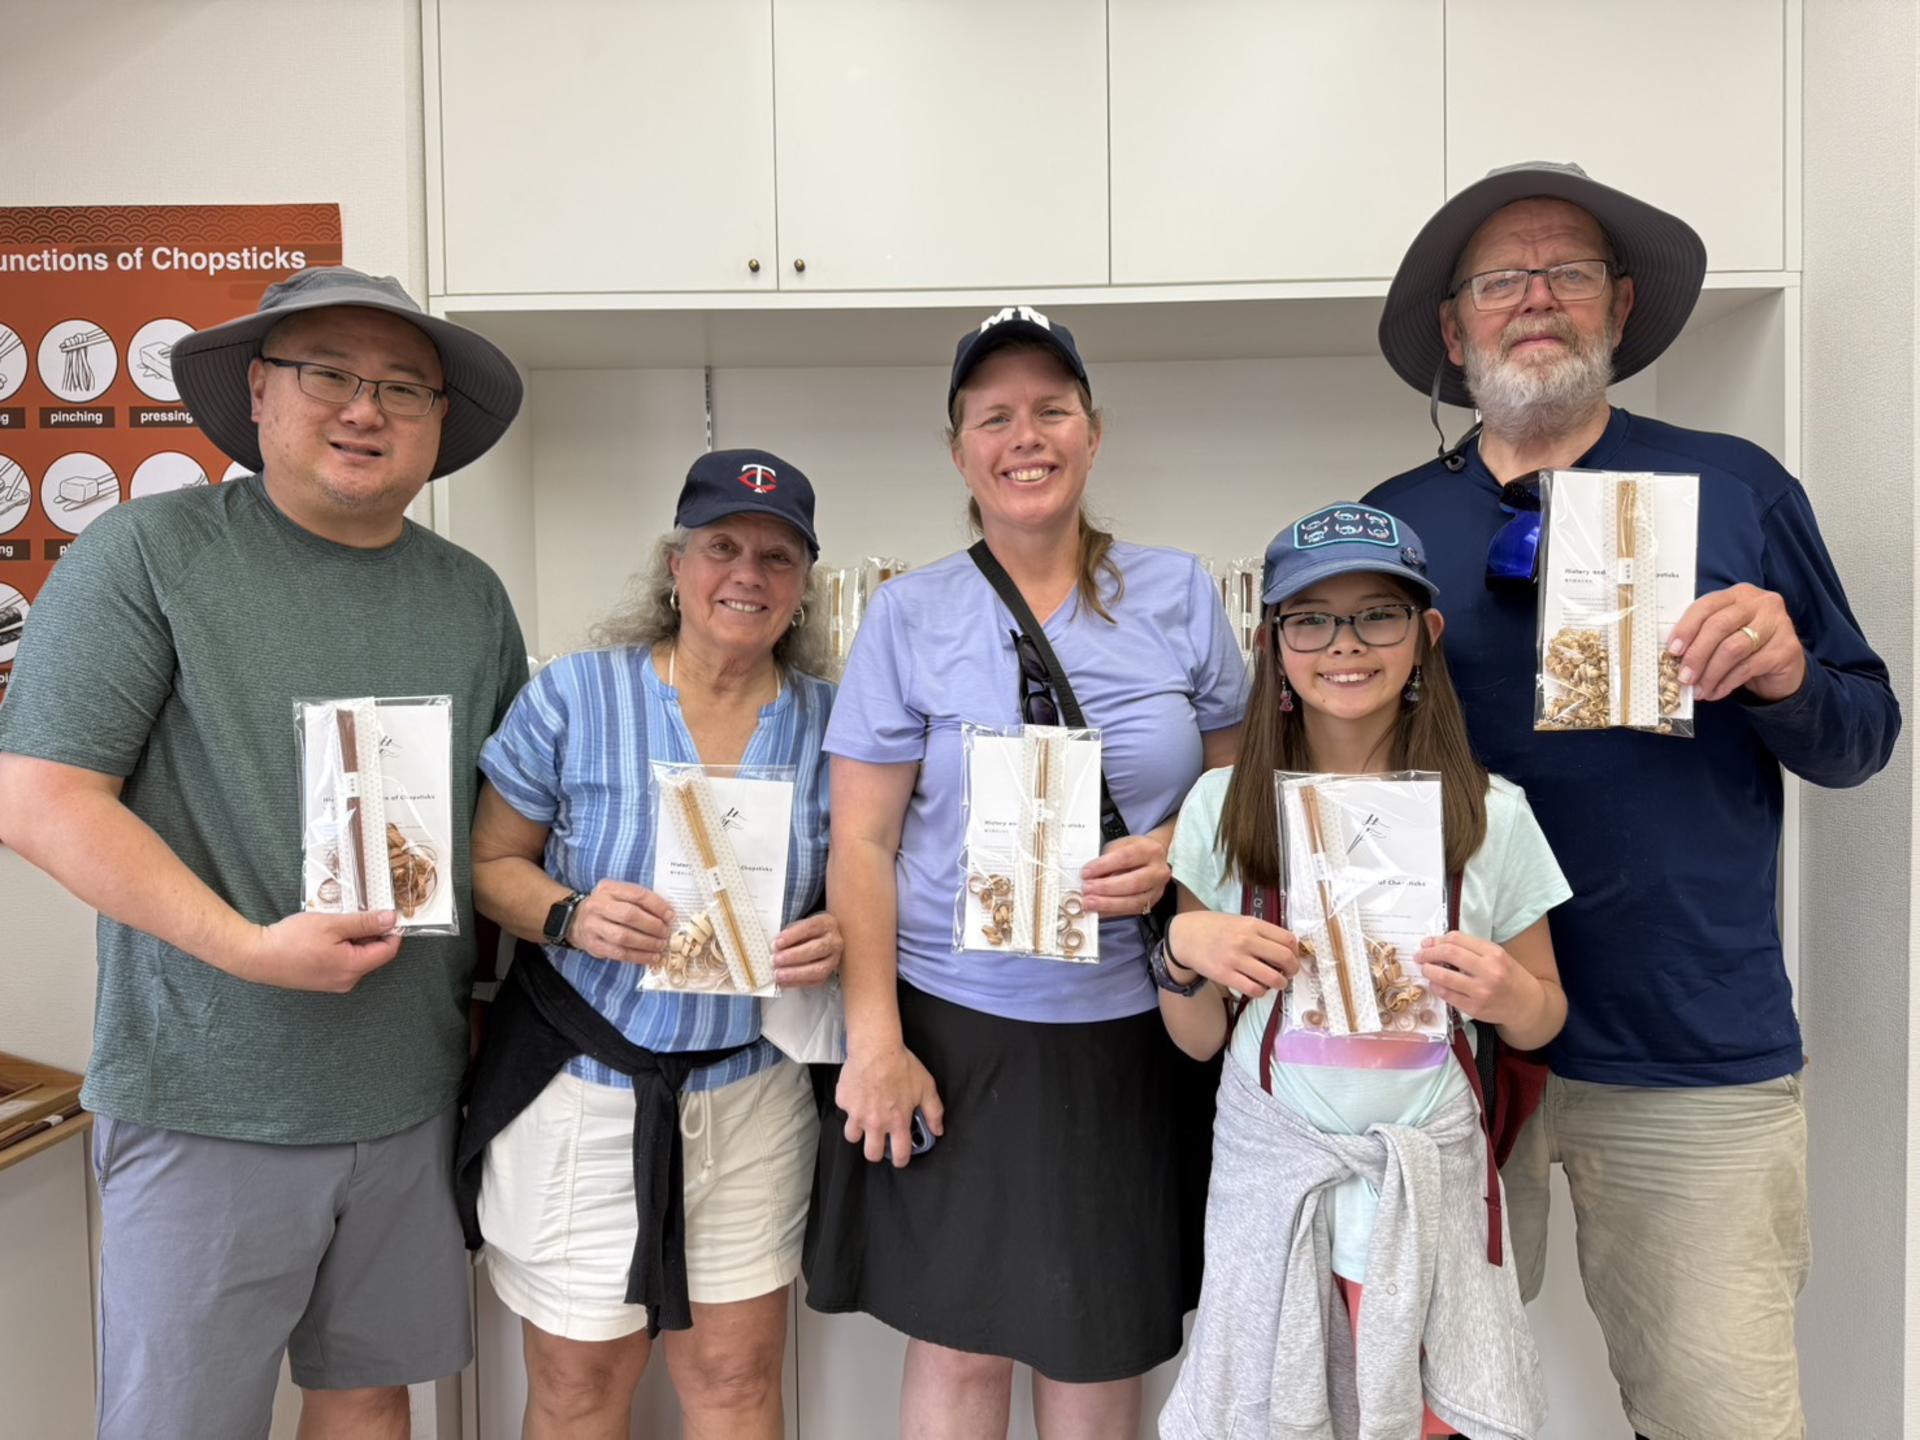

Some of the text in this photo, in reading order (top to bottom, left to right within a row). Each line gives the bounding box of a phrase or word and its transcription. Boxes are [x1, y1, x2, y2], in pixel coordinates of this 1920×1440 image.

[117, 248, 144, 271] of
[151, 246, 306, 275] Chopsticks
[50, 411, 103, 424] pinching
